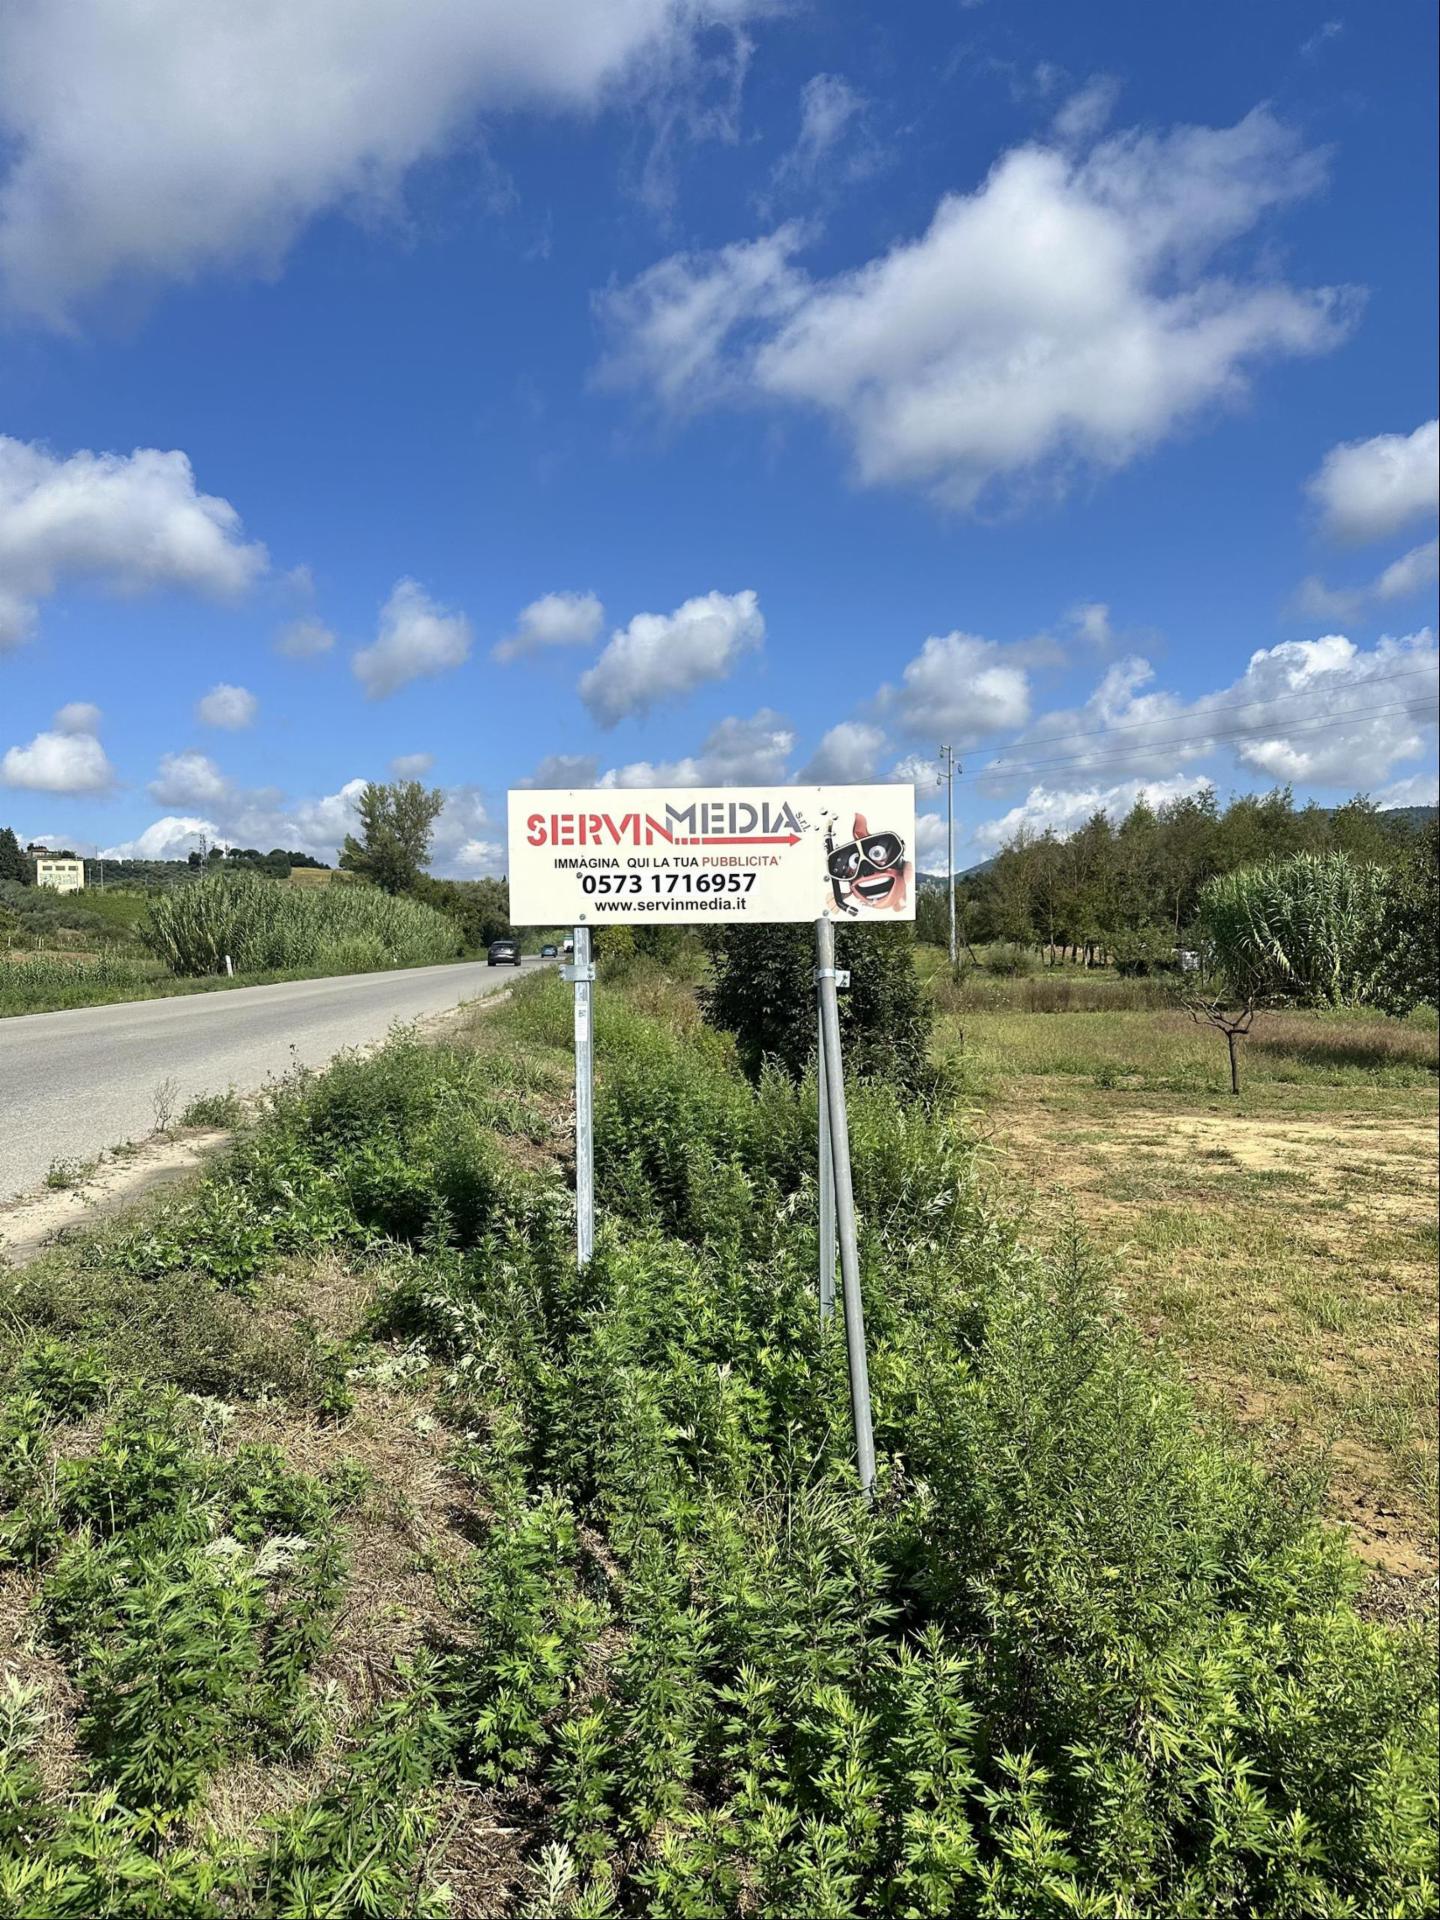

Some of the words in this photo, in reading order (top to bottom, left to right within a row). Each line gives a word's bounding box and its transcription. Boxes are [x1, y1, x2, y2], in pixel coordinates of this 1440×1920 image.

[554, 858, 620, 869] IMMAGINA
[627, 857, 649, 869] QUI
[653, 857, 670, 868] LA
[673, 857, 699, 867] TUA
[582, 874, 642, 894] 0573
[651, 873, 757, 893] 1716957
[595, 897, 747, 912] www.servinmedia.it
